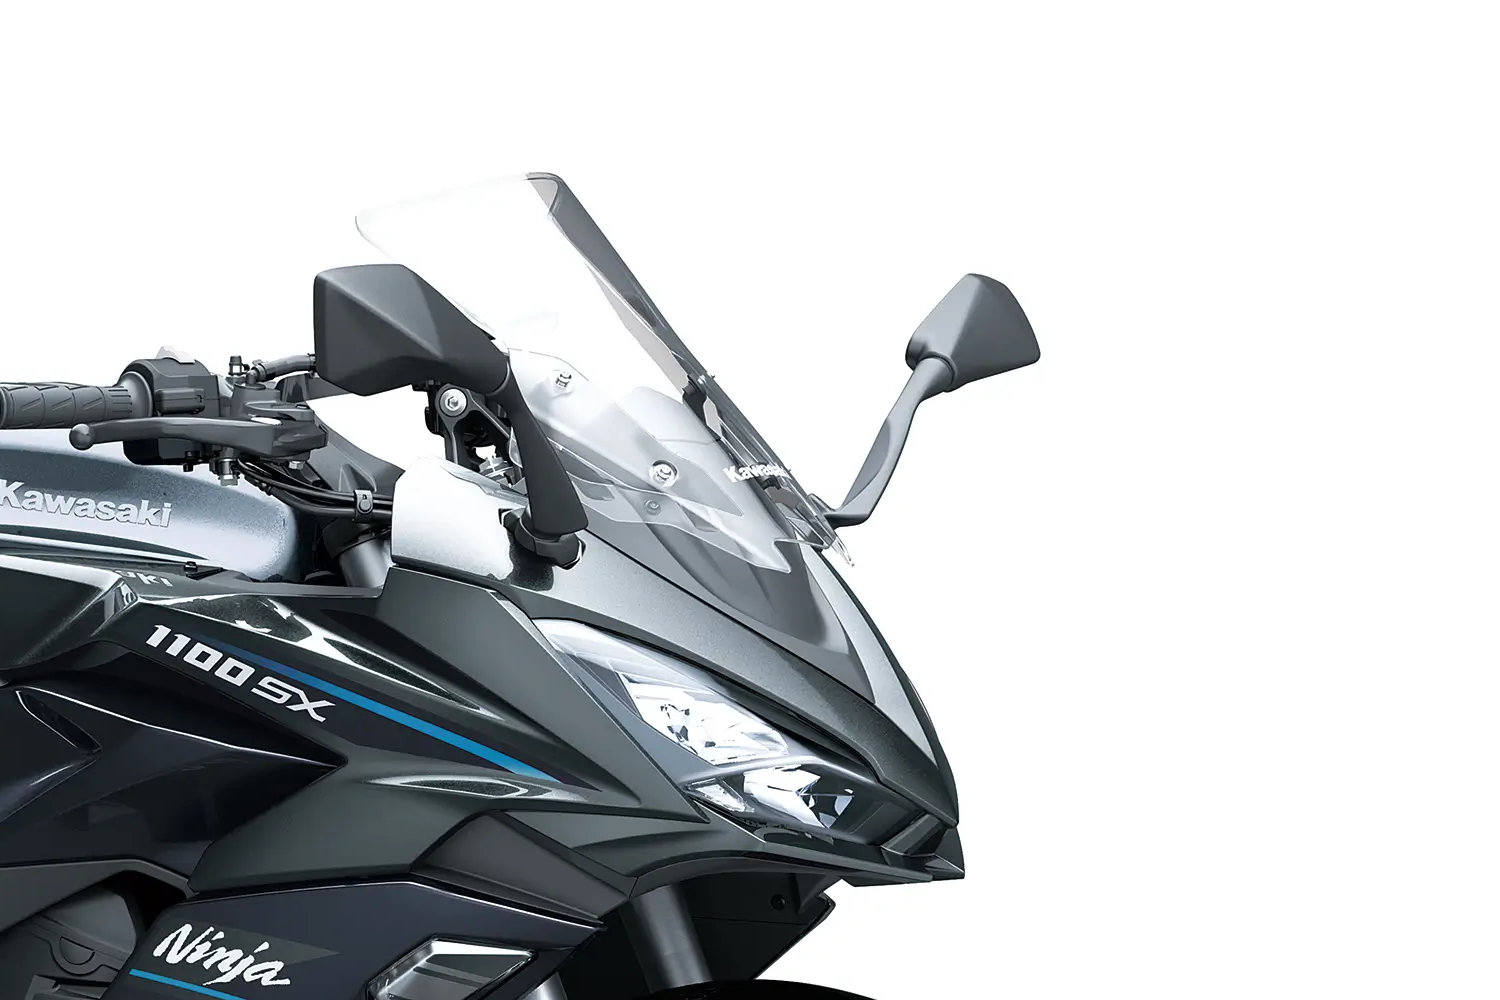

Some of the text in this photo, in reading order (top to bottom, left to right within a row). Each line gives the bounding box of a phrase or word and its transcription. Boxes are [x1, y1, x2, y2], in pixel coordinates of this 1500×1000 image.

[723, 462, 792, 484] Kawas
[145, 624, 336, 723] 1100 SX
[153, 924, 291, 986] Ninja
